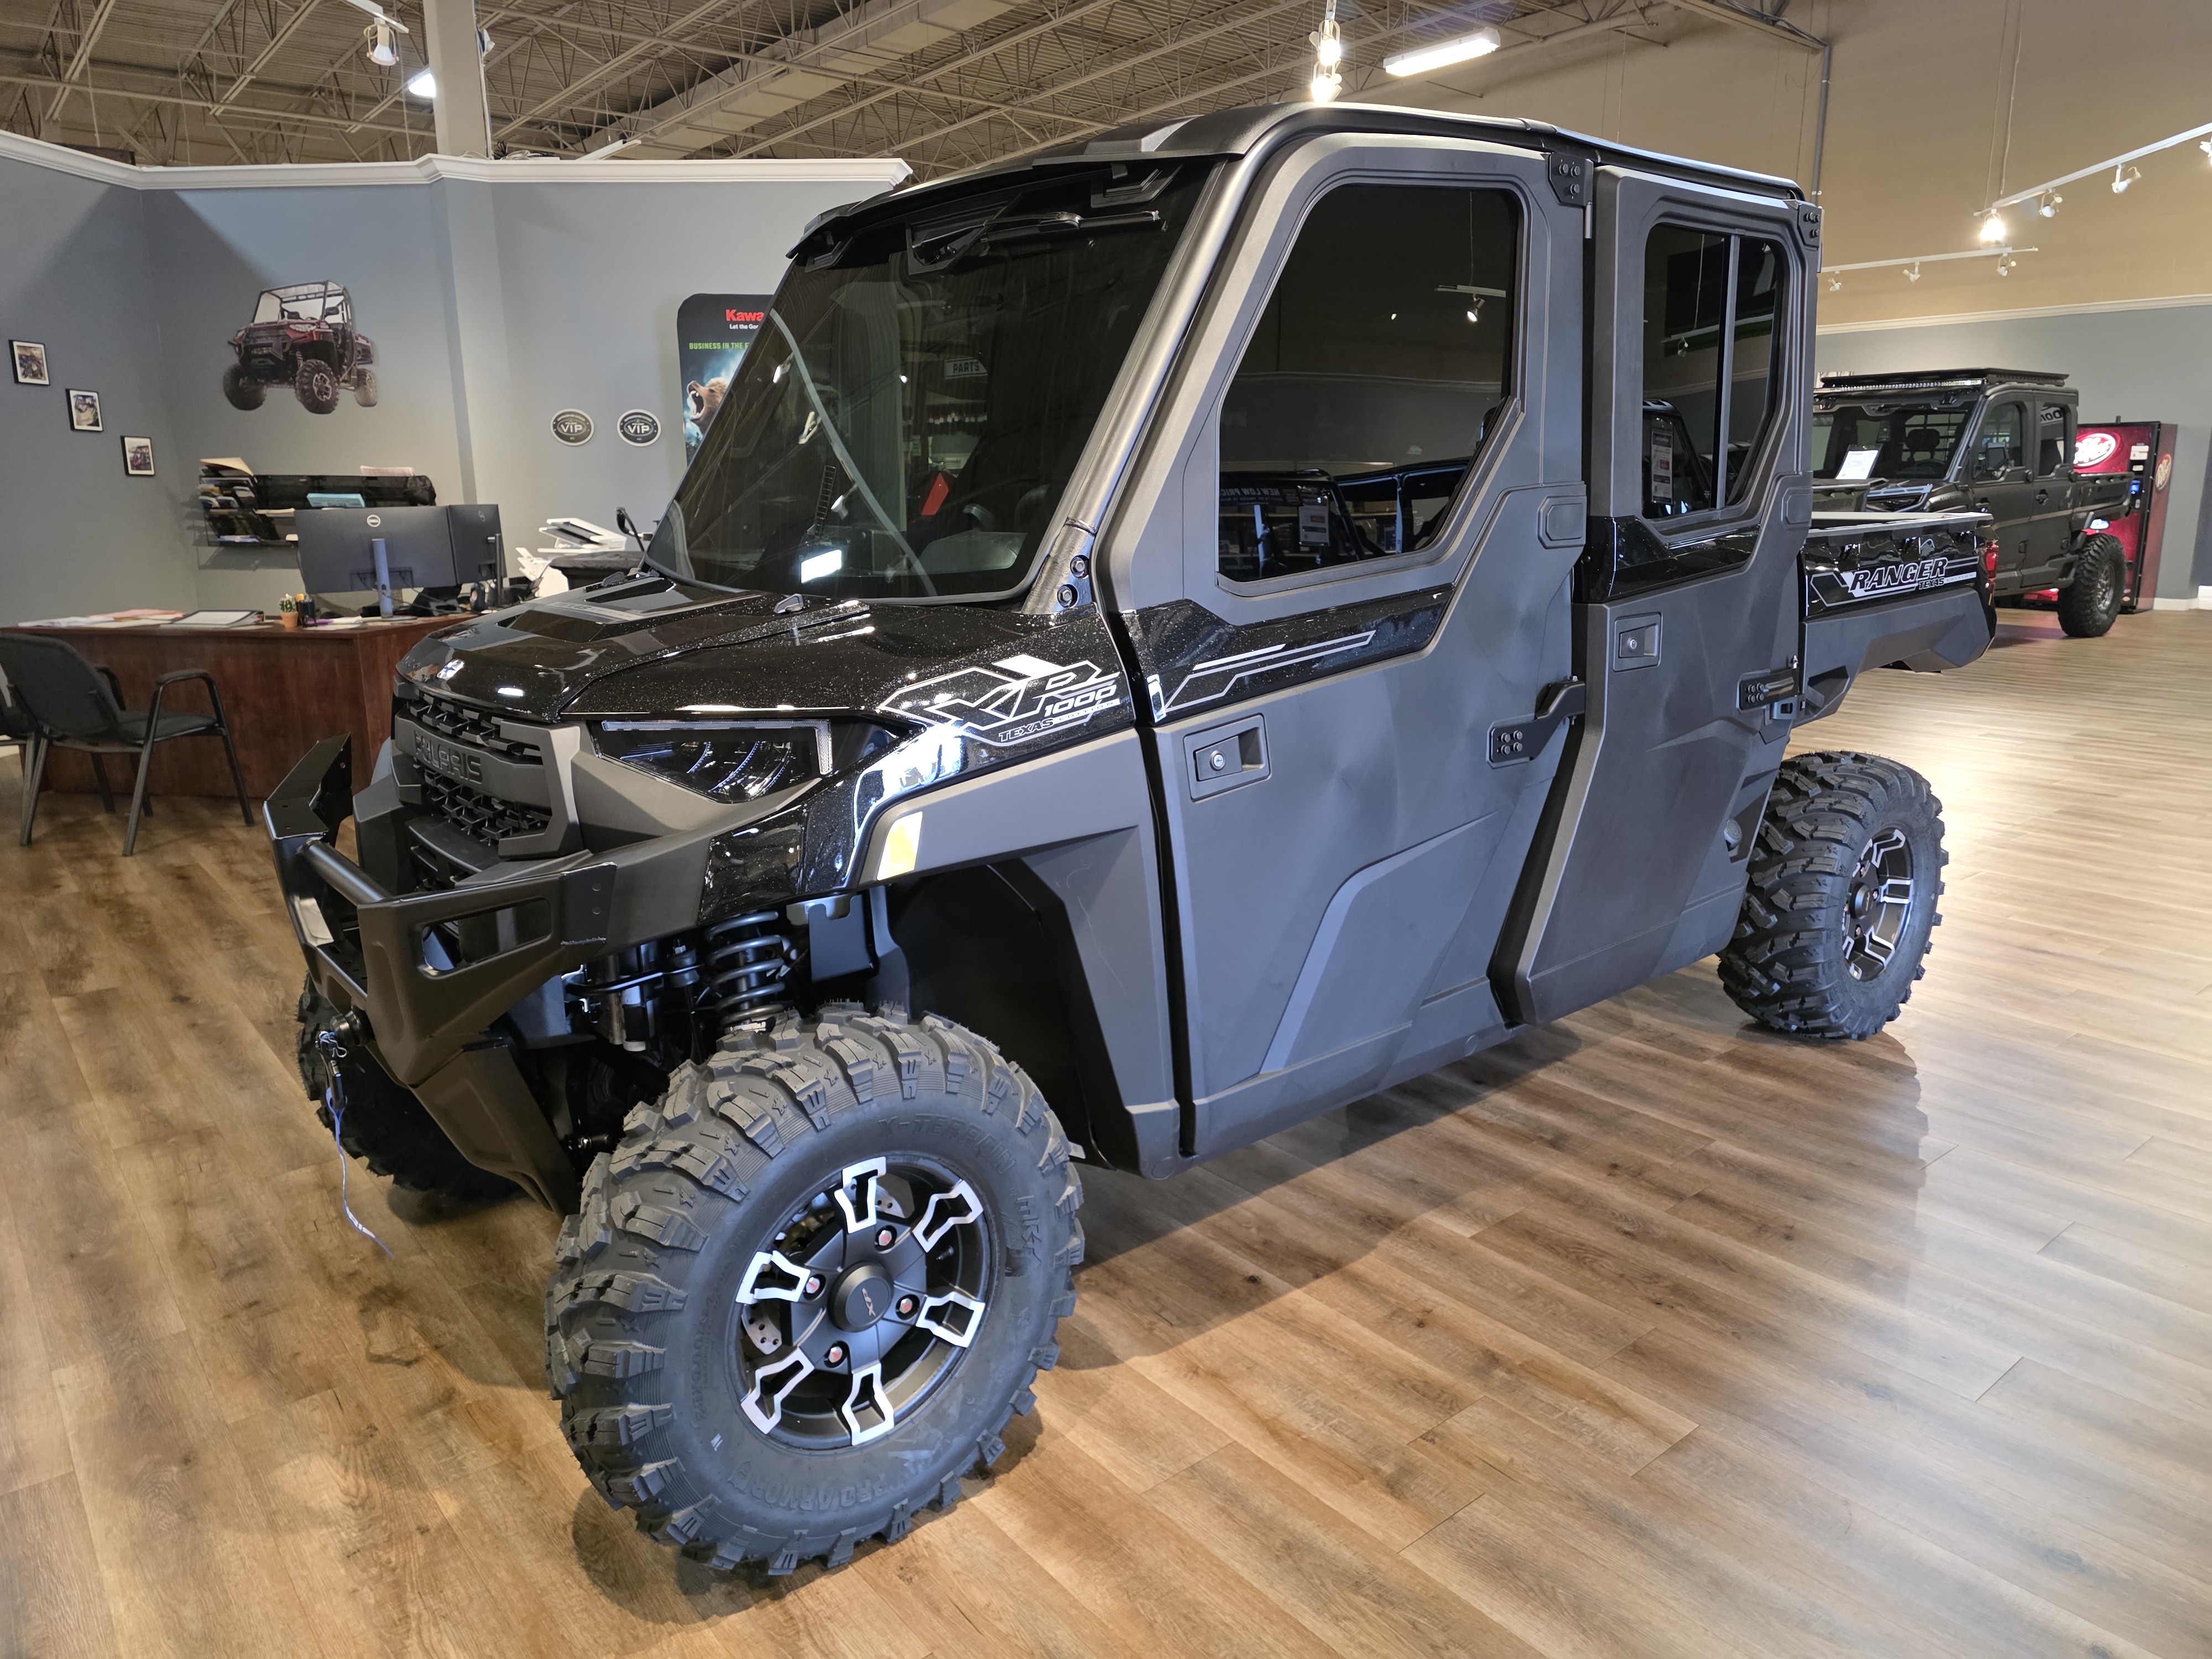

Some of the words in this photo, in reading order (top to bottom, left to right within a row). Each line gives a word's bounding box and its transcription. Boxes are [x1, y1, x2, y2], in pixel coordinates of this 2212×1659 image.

[726, 309, 764, 321] Kawa
[953, 361, 979, 374] PARTS
[560, 424, 583, 433] VIP
[628, 425, 650, 434] VIP
[1848, 557, 1948, 593] RANGER
[1918, 578, 1945, 590] TEXAS
[1947, 573, 1974, 582] EDITION
[1044, 684, 1117, 717] 1000
[998, 719, 1054, 742] TEXAS
[1058, 701, 1114, 722] EDITION
[414, 730, 483, 785] POLARIS
